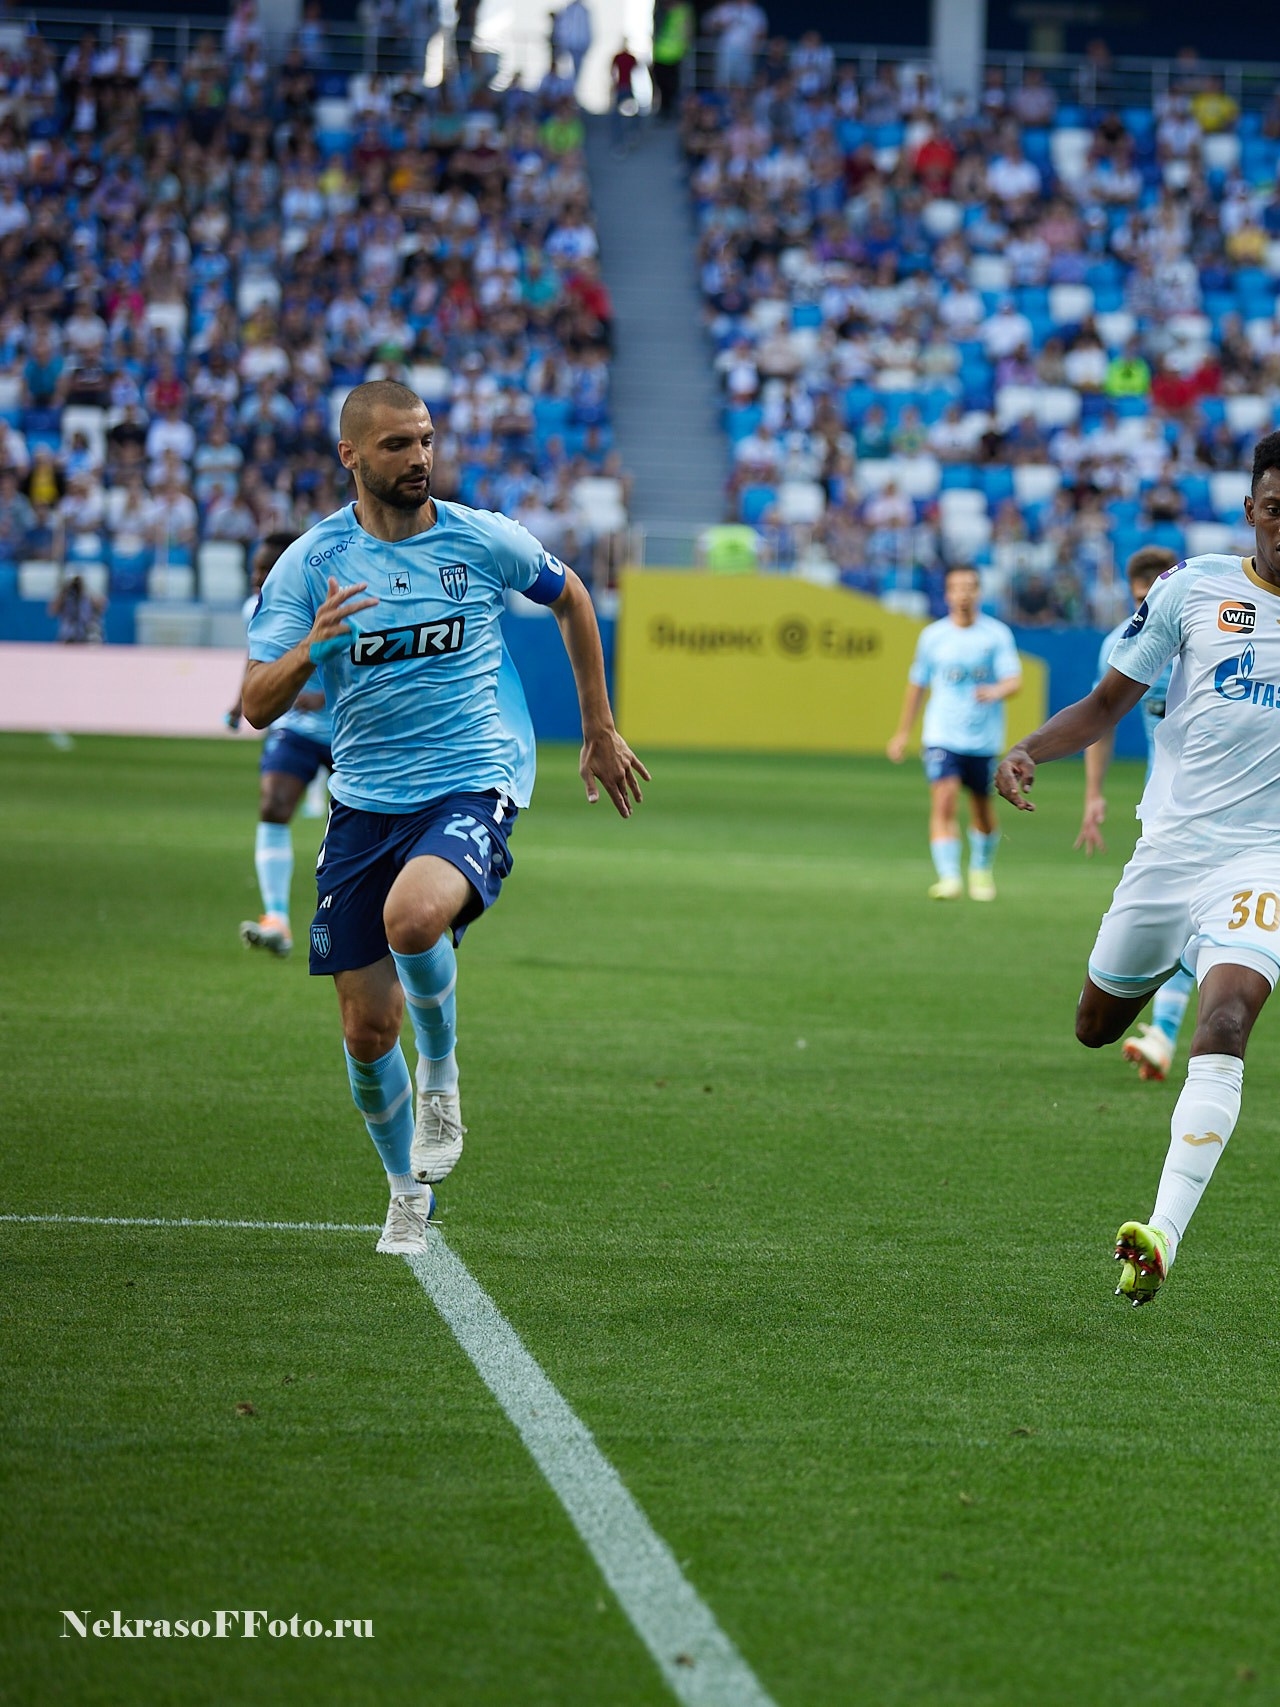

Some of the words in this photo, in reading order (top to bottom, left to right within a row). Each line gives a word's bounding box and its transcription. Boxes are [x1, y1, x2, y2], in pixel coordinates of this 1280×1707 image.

[309, 536, 355, 567] GloraX
[1225, 609, 1254, 625] Win
[354, 620, 461, 662] PARI
[443, 813, 491, 859] 24
